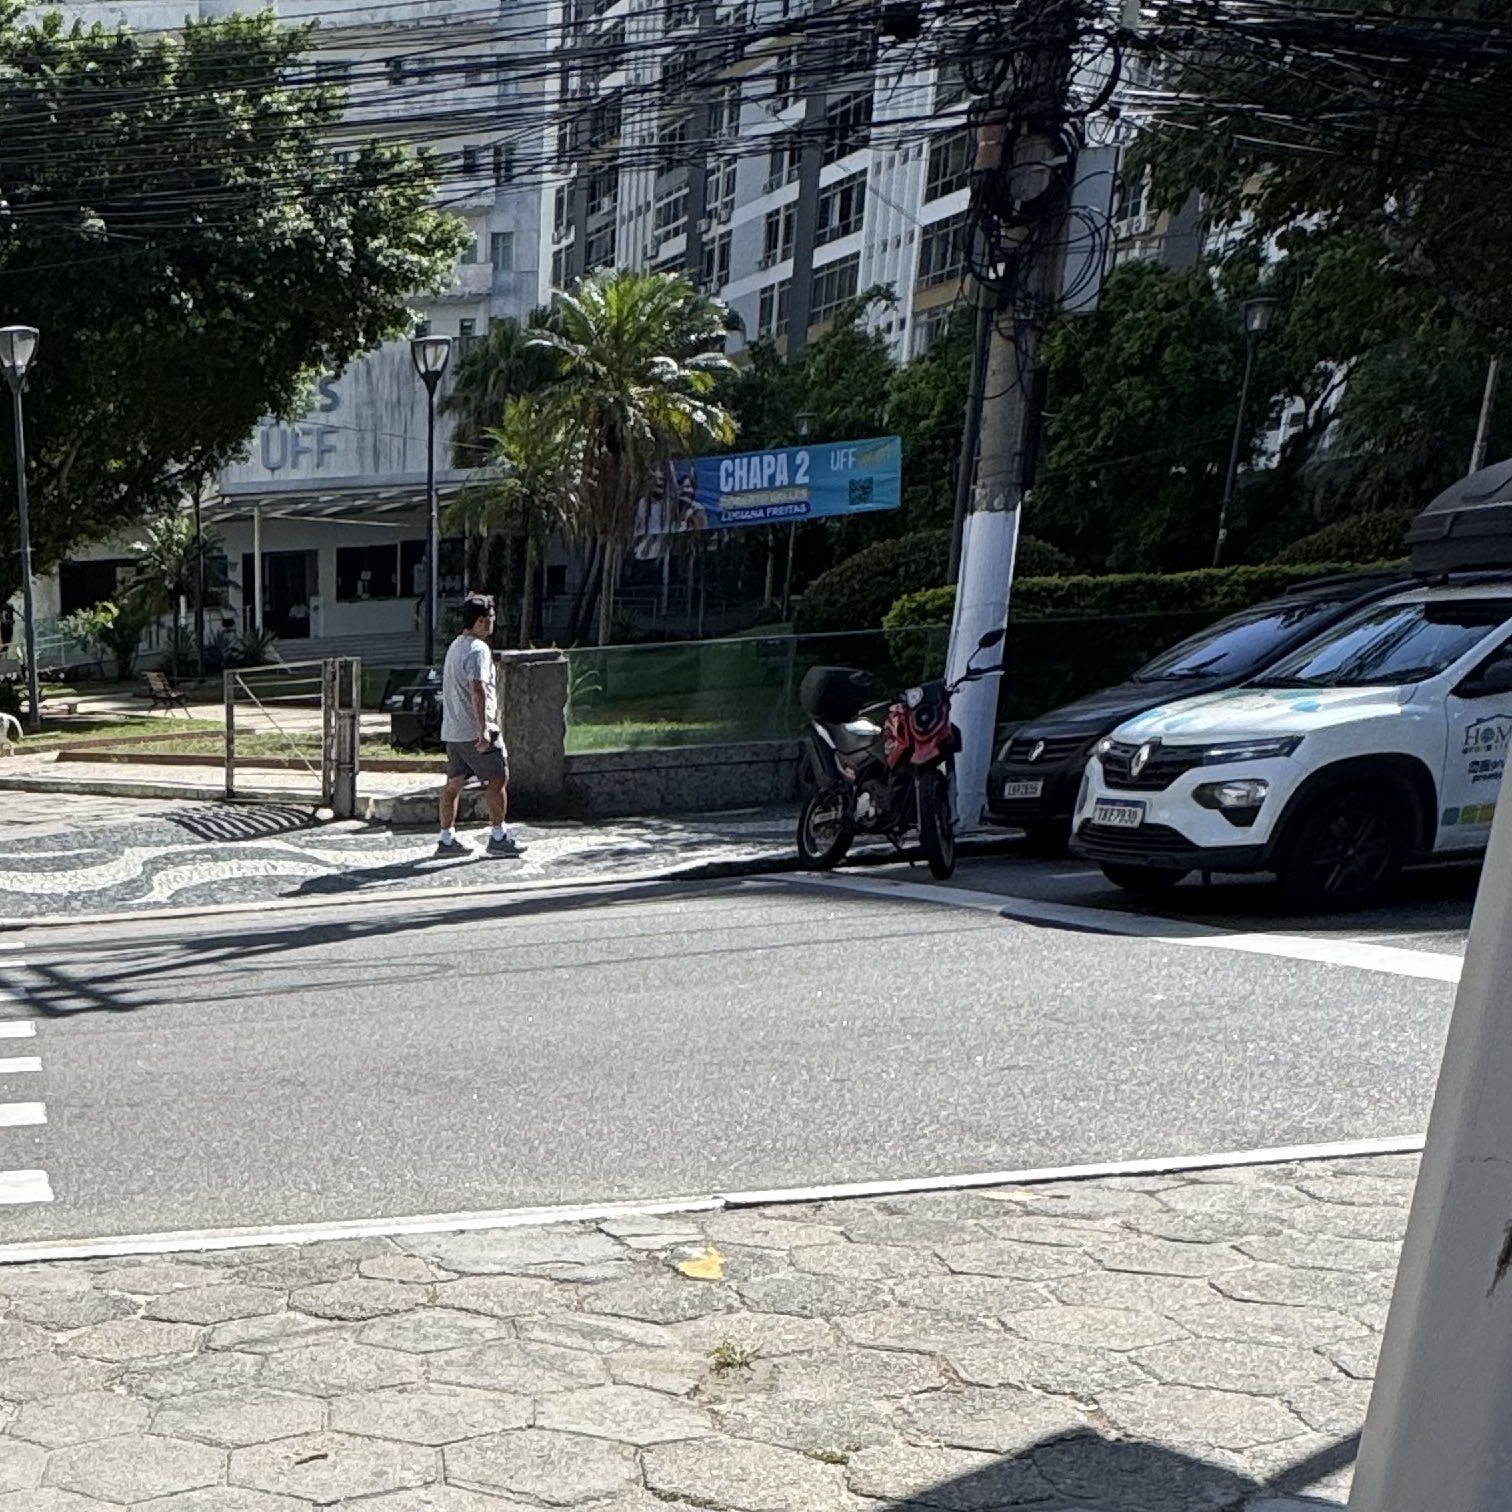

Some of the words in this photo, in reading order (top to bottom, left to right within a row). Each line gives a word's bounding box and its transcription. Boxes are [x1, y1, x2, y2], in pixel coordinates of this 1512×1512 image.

[260, 427, 339, 471] UFF
[830, 449, 857, 471] UFF
[719, 453, 788, 493] CHAPA
[794, 450, 810, 485] 2
